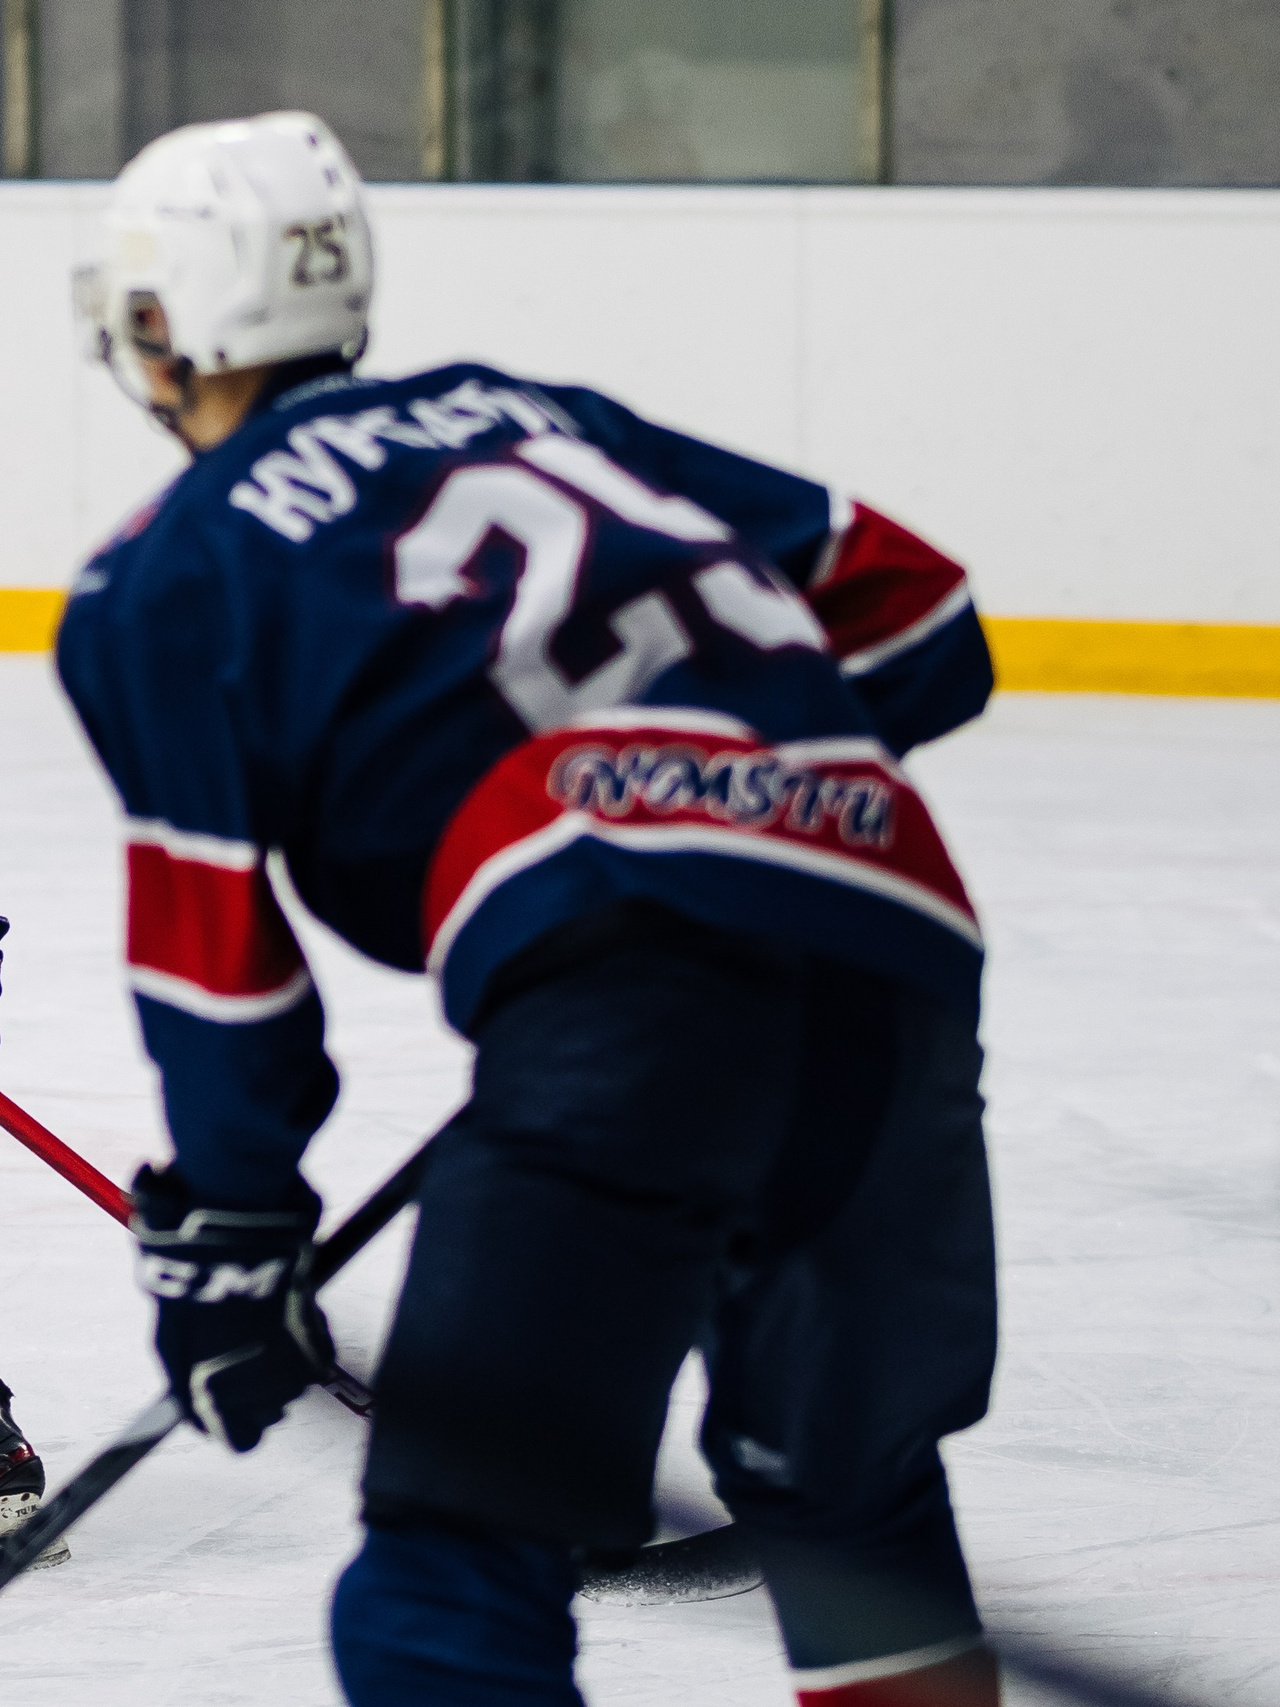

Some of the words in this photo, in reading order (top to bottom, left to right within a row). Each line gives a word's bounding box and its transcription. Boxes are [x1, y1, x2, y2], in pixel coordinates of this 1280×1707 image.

[283, 213, 350, 288] 25
[387, 430, 832, 737] 25
[135, 1254, 289, 1302] CM
